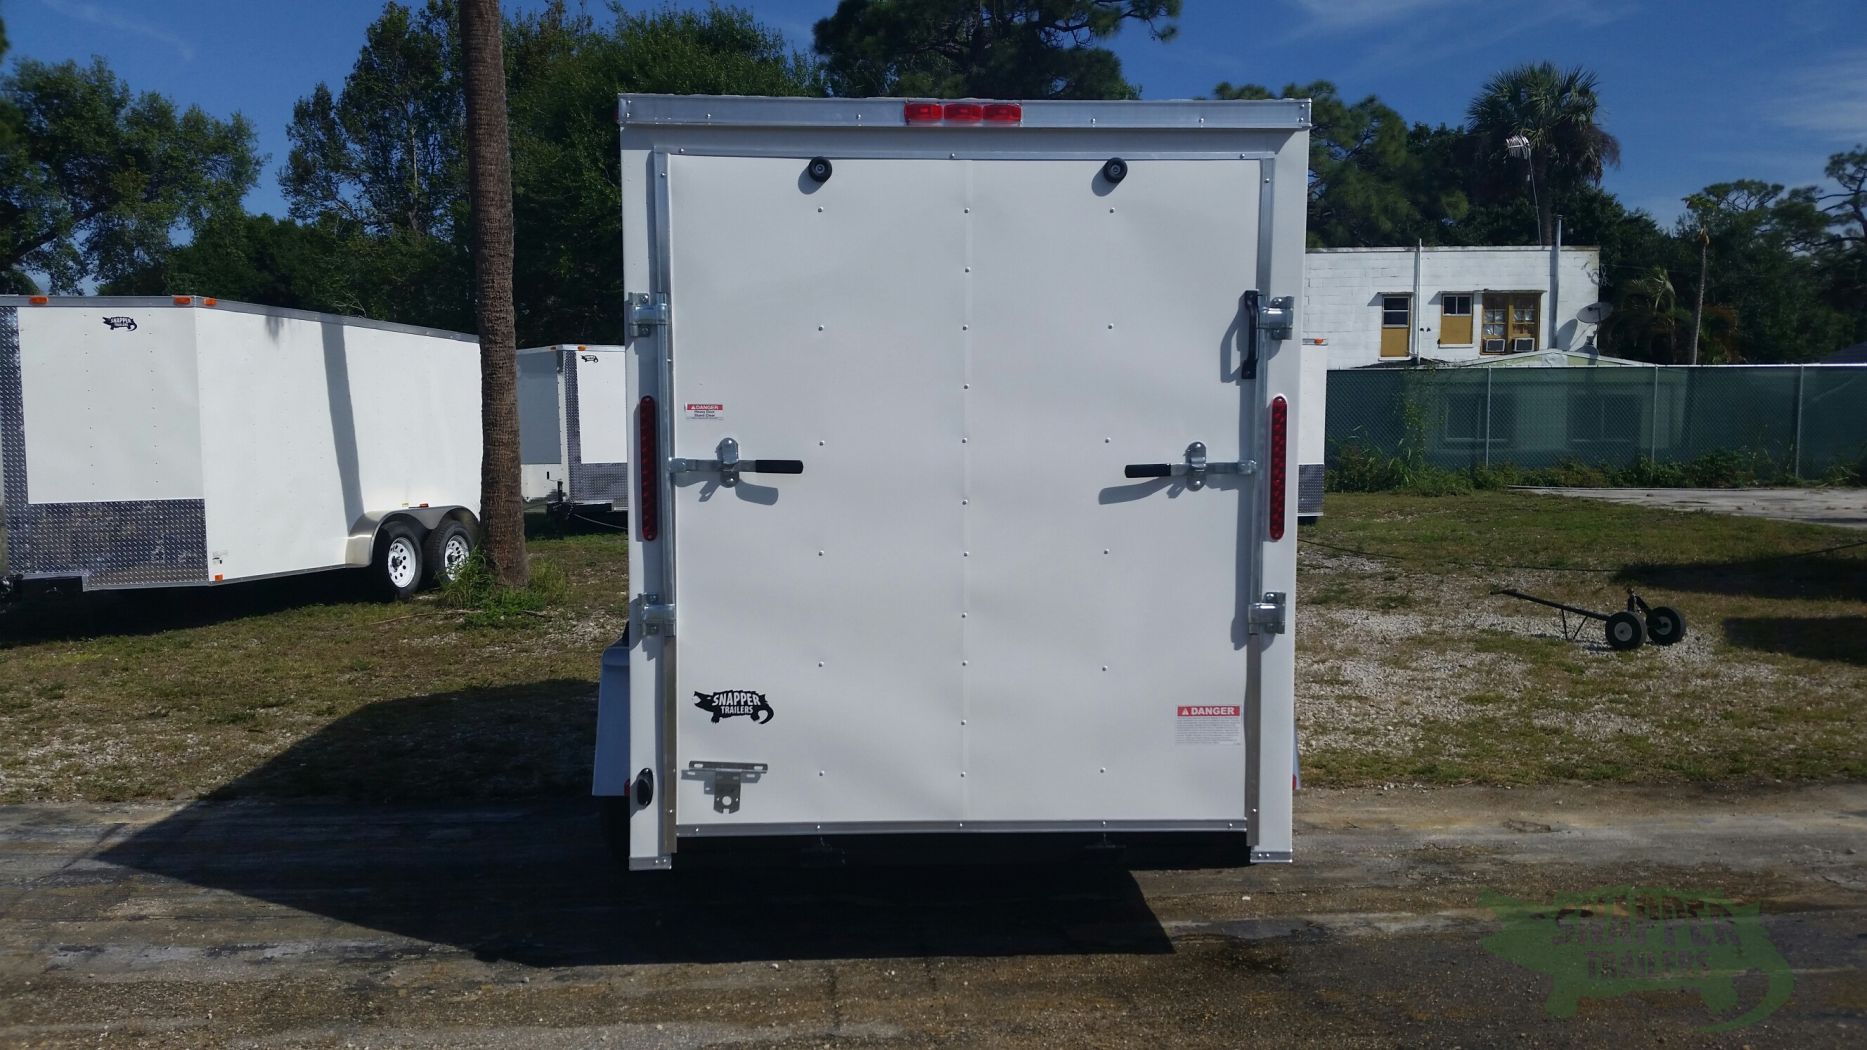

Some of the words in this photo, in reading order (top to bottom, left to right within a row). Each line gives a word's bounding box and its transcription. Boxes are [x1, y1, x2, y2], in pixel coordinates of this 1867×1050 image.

[712, 692, 761, 706] SNAPPER
[721, 705, 753, 714] TRAILERS
[1191, 706, 1235, 716] DANGER
